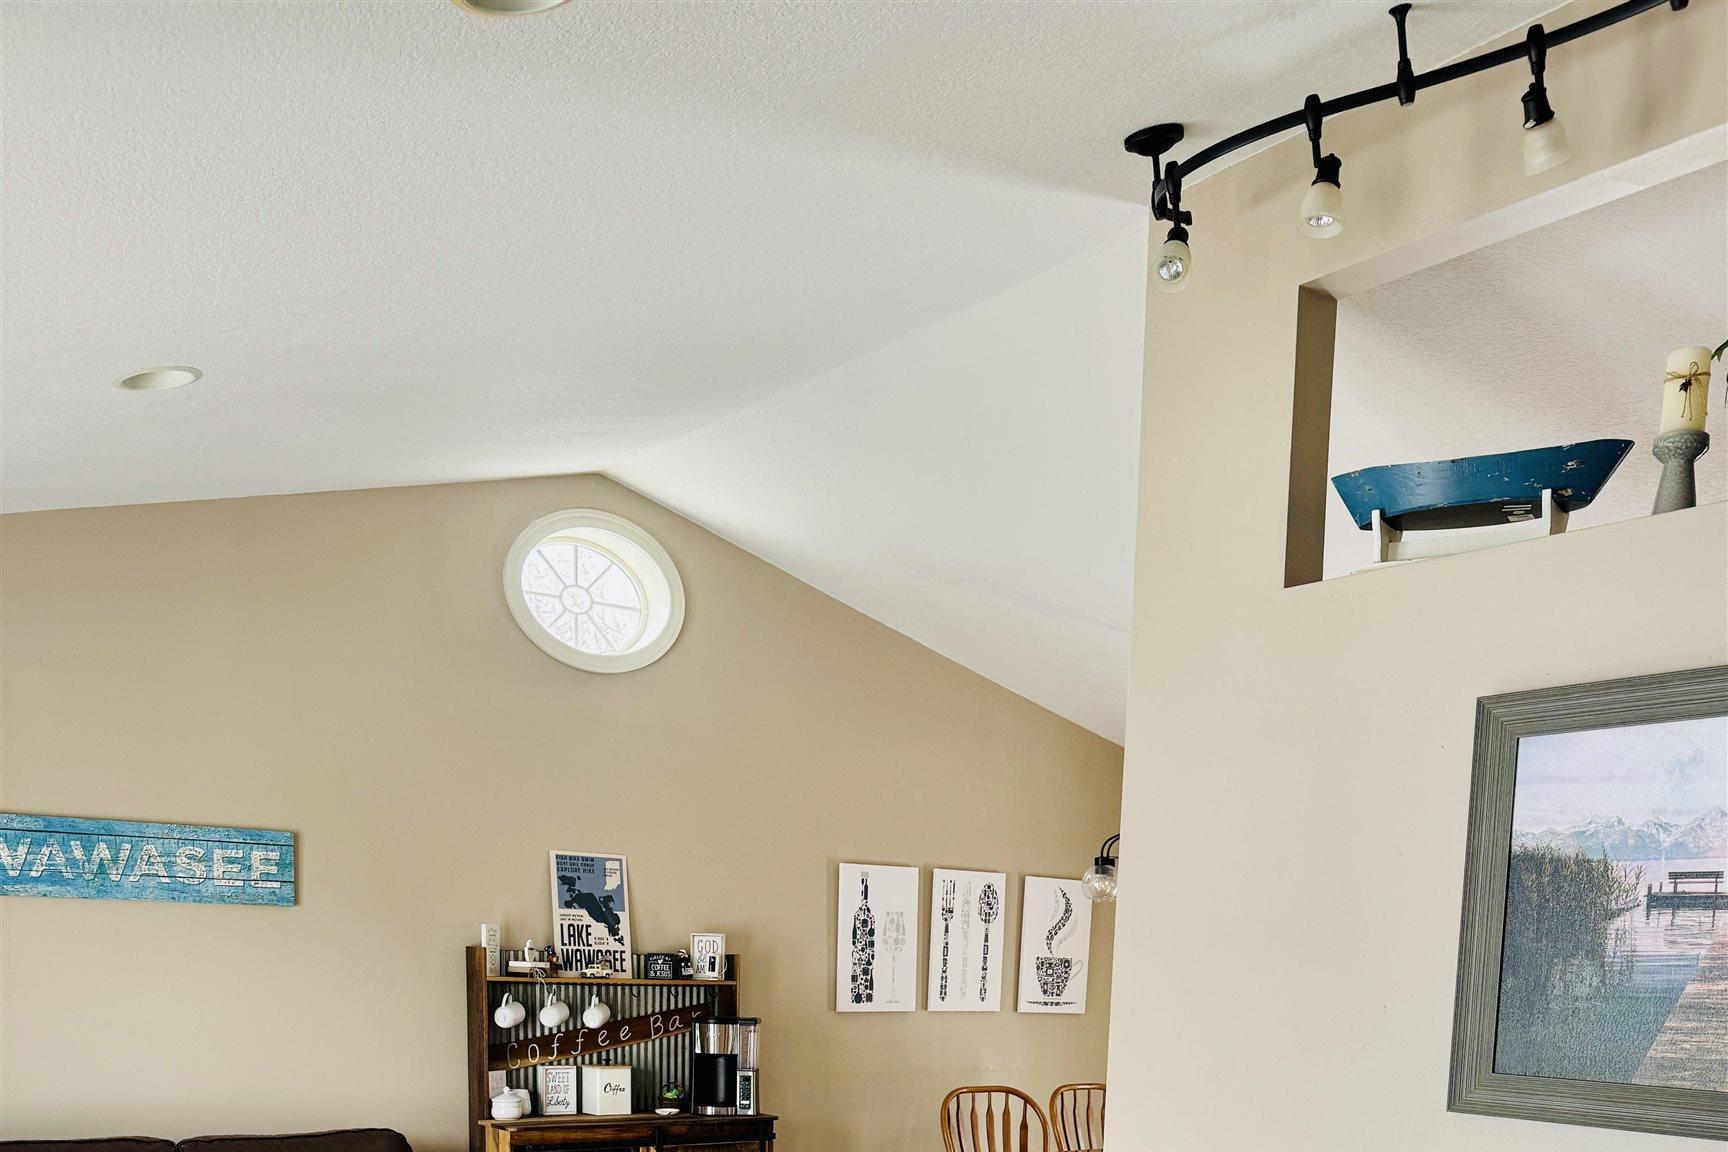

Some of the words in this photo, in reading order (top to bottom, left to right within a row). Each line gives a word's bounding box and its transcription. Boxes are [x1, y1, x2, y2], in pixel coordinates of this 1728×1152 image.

[560, 923, 592, 947] LAKE
[697, 940, 718, 953] GOD
[507, 1025, 631, 1069] Coffee
[547, 1071, 570, 1083] SWEET
[603, 1082, 626, 1095] Coffee
[546, 1095, 570, 1109] Liberty
